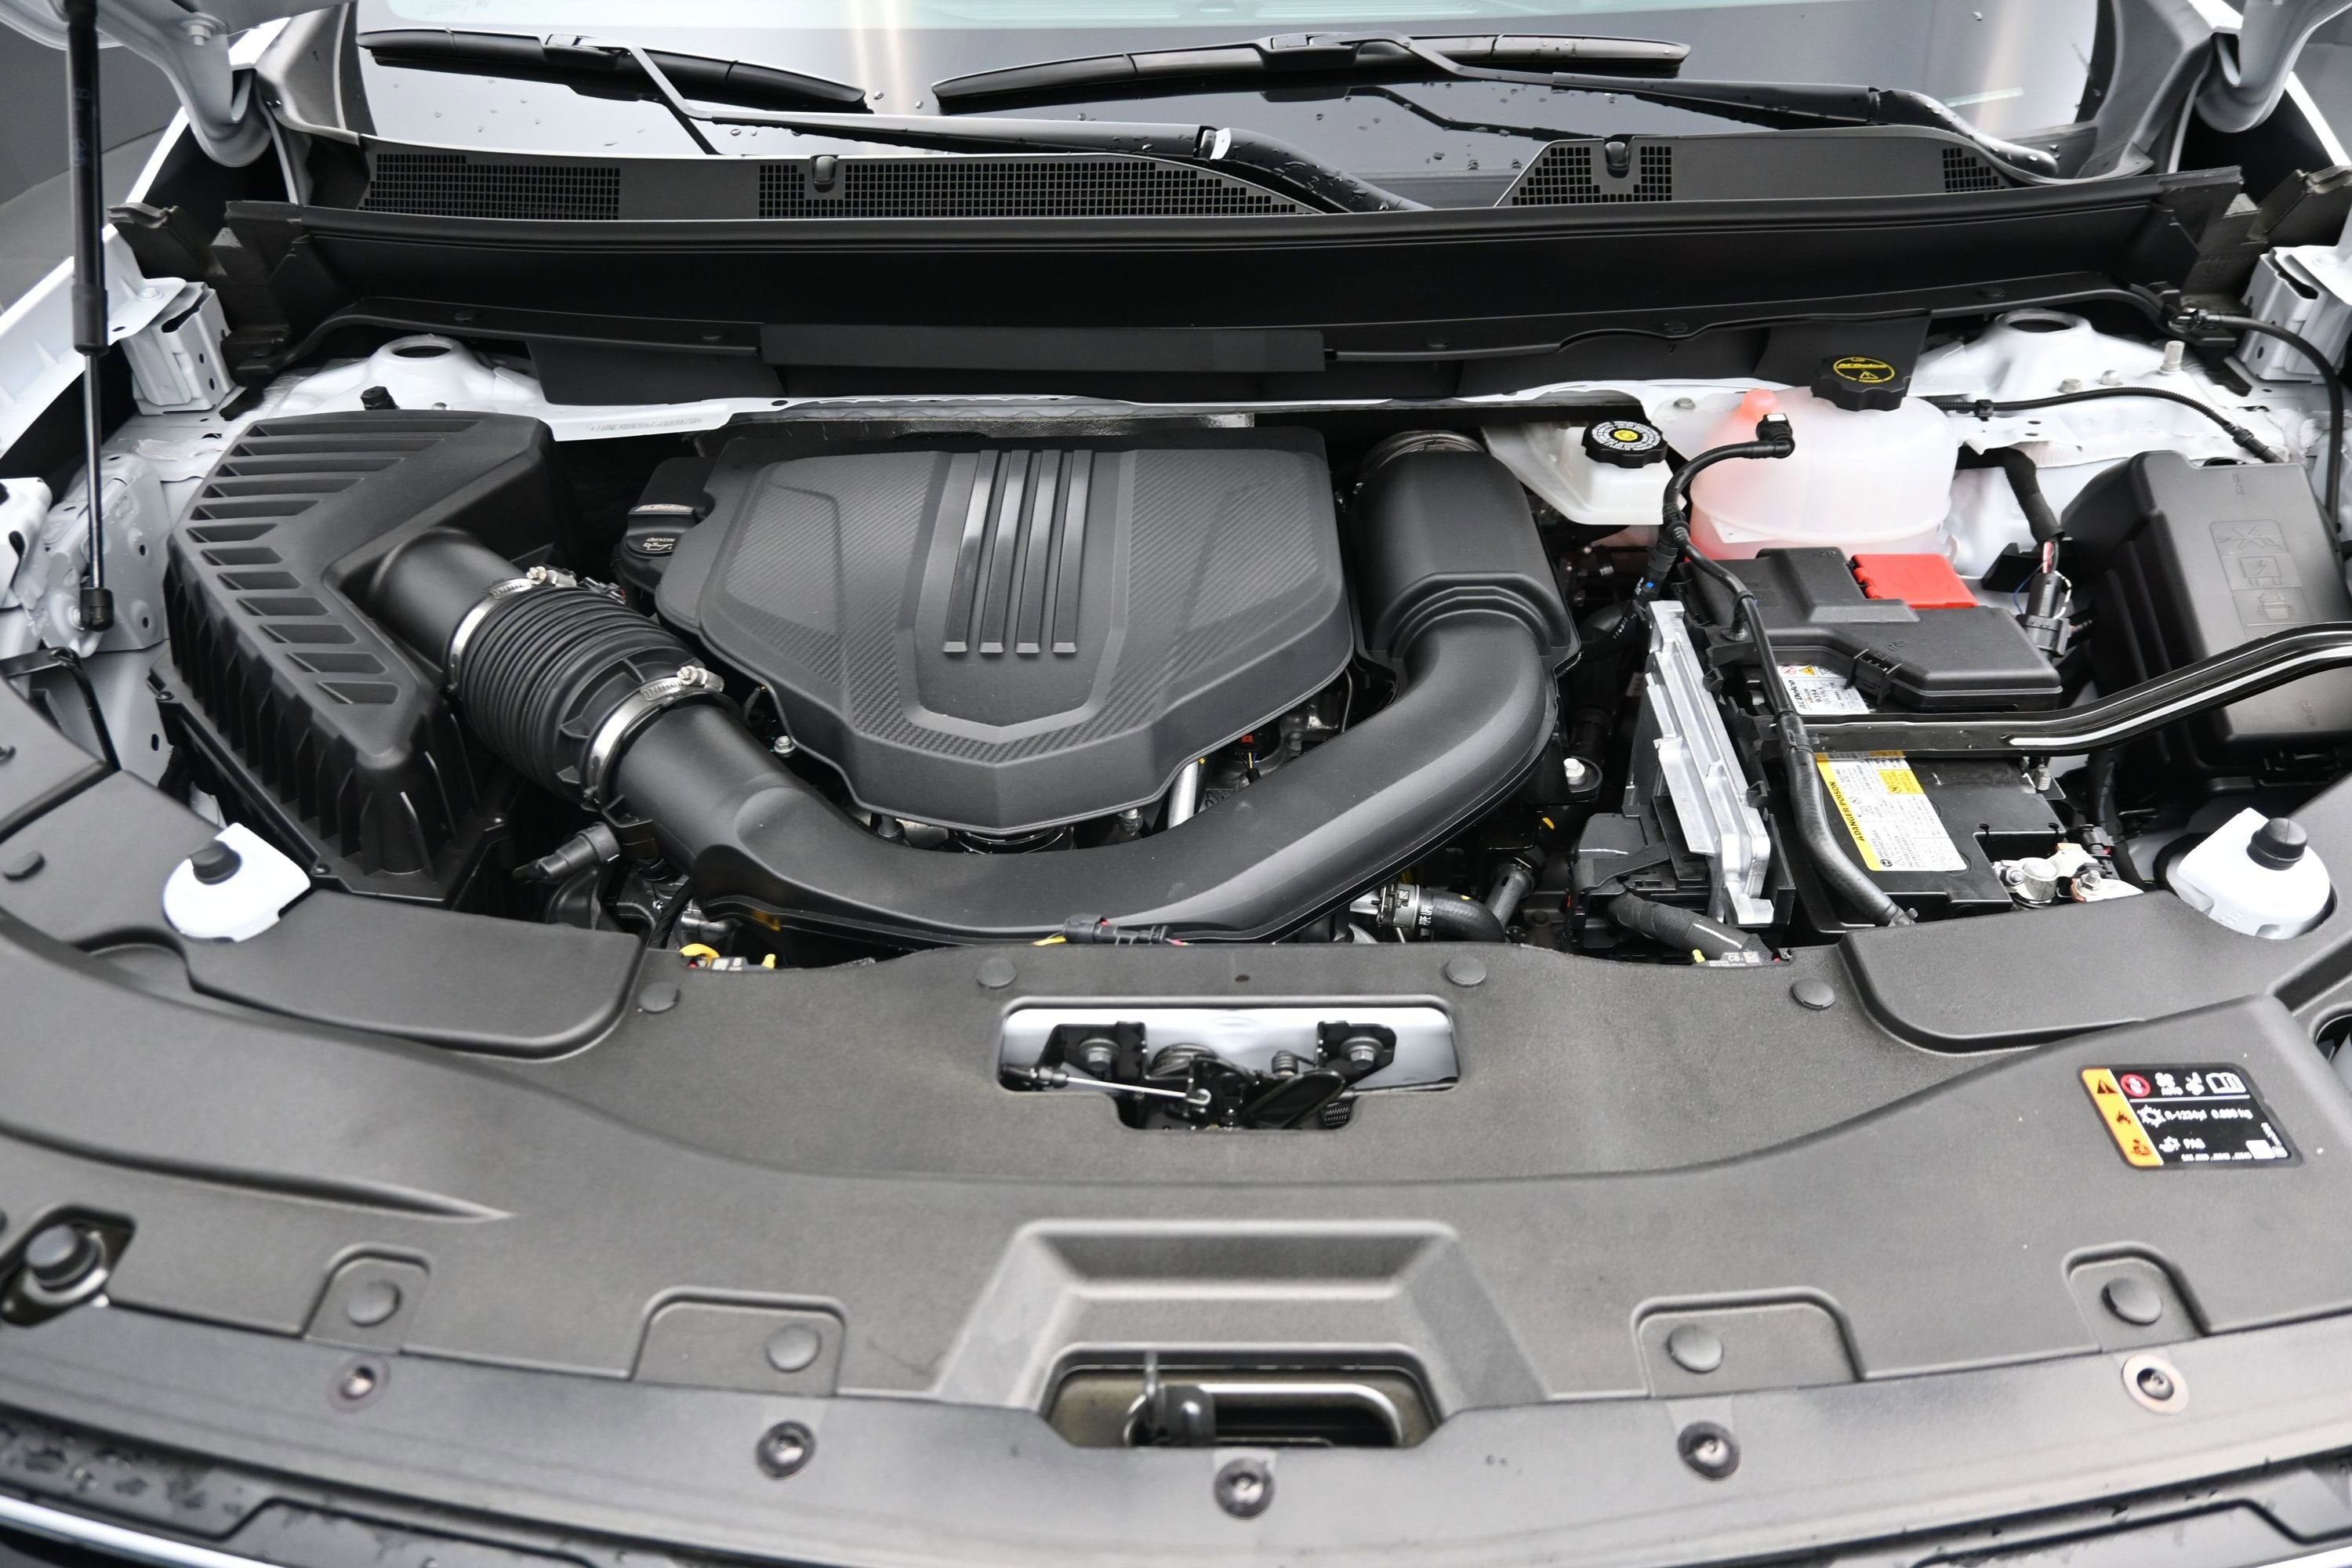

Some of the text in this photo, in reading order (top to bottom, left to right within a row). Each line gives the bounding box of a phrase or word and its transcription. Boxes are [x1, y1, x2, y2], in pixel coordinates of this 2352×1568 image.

[1788, 680, 1807, 710] ACDelco
[1828, 781, 1861, 834] DANGER POISON
